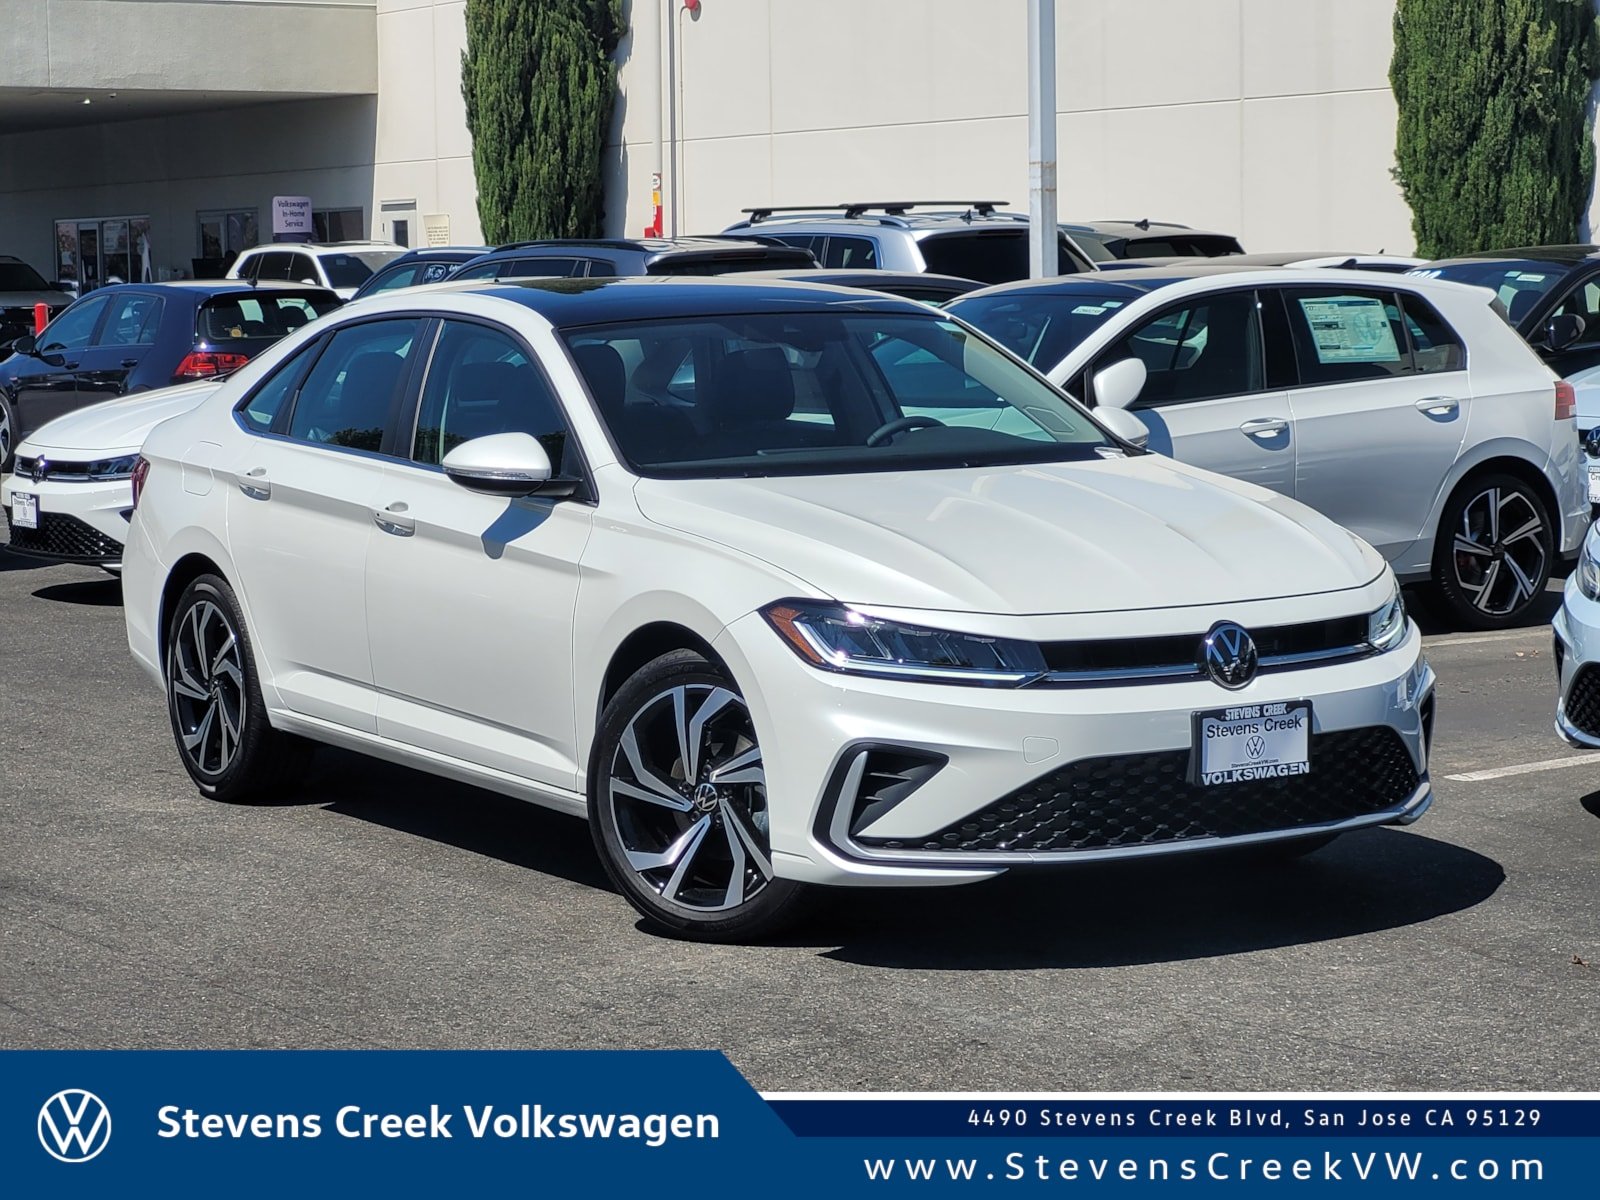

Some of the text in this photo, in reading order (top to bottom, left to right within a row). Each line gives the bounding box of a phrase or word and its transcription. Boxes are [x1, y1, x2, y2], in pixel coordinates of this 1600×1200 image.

[277, 199, 309, 209] Volkswagen
[282, 209, 305, 217] In-Home
[284, 219, 304, 227] Service
[1225, 703, 1287, 721] STEVENS CREEK
[1206, 715, 1302, 738] Stevens Creek
[1231, 758, 1279, 769] StevensCreekVW.com
[1201, 762, 1310, 786] VOLKSWAGEN
